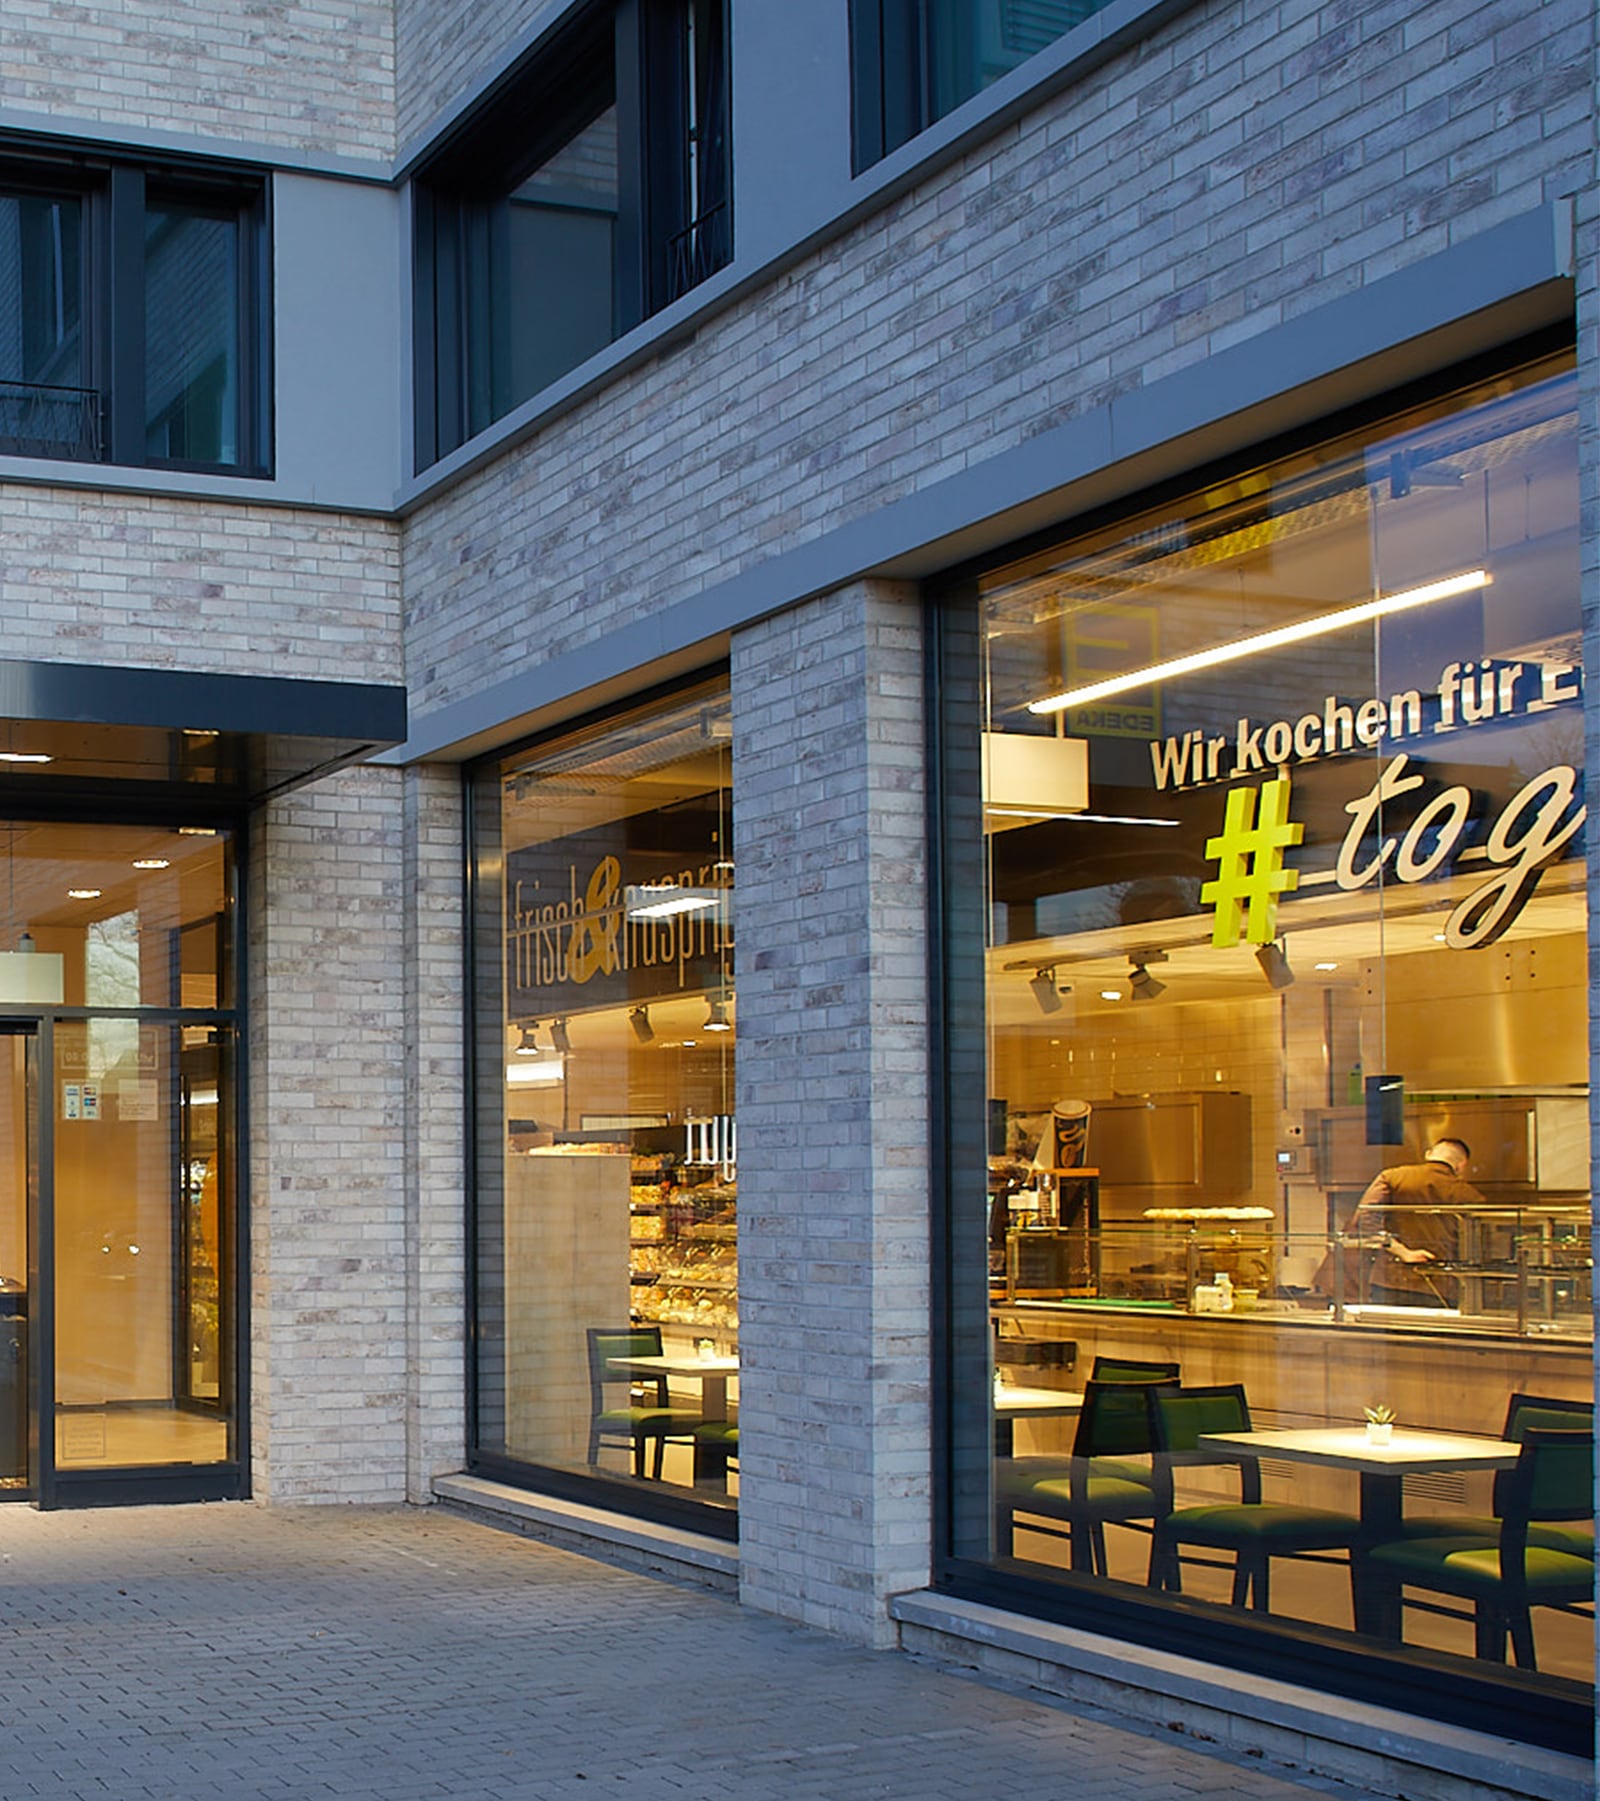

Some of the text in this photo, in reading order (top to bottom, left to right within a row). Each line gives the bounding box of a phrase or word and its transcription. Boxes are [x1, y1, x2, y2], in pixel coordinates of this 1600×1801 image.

[1150, 658, 1586, 790] Wir kochen für E
